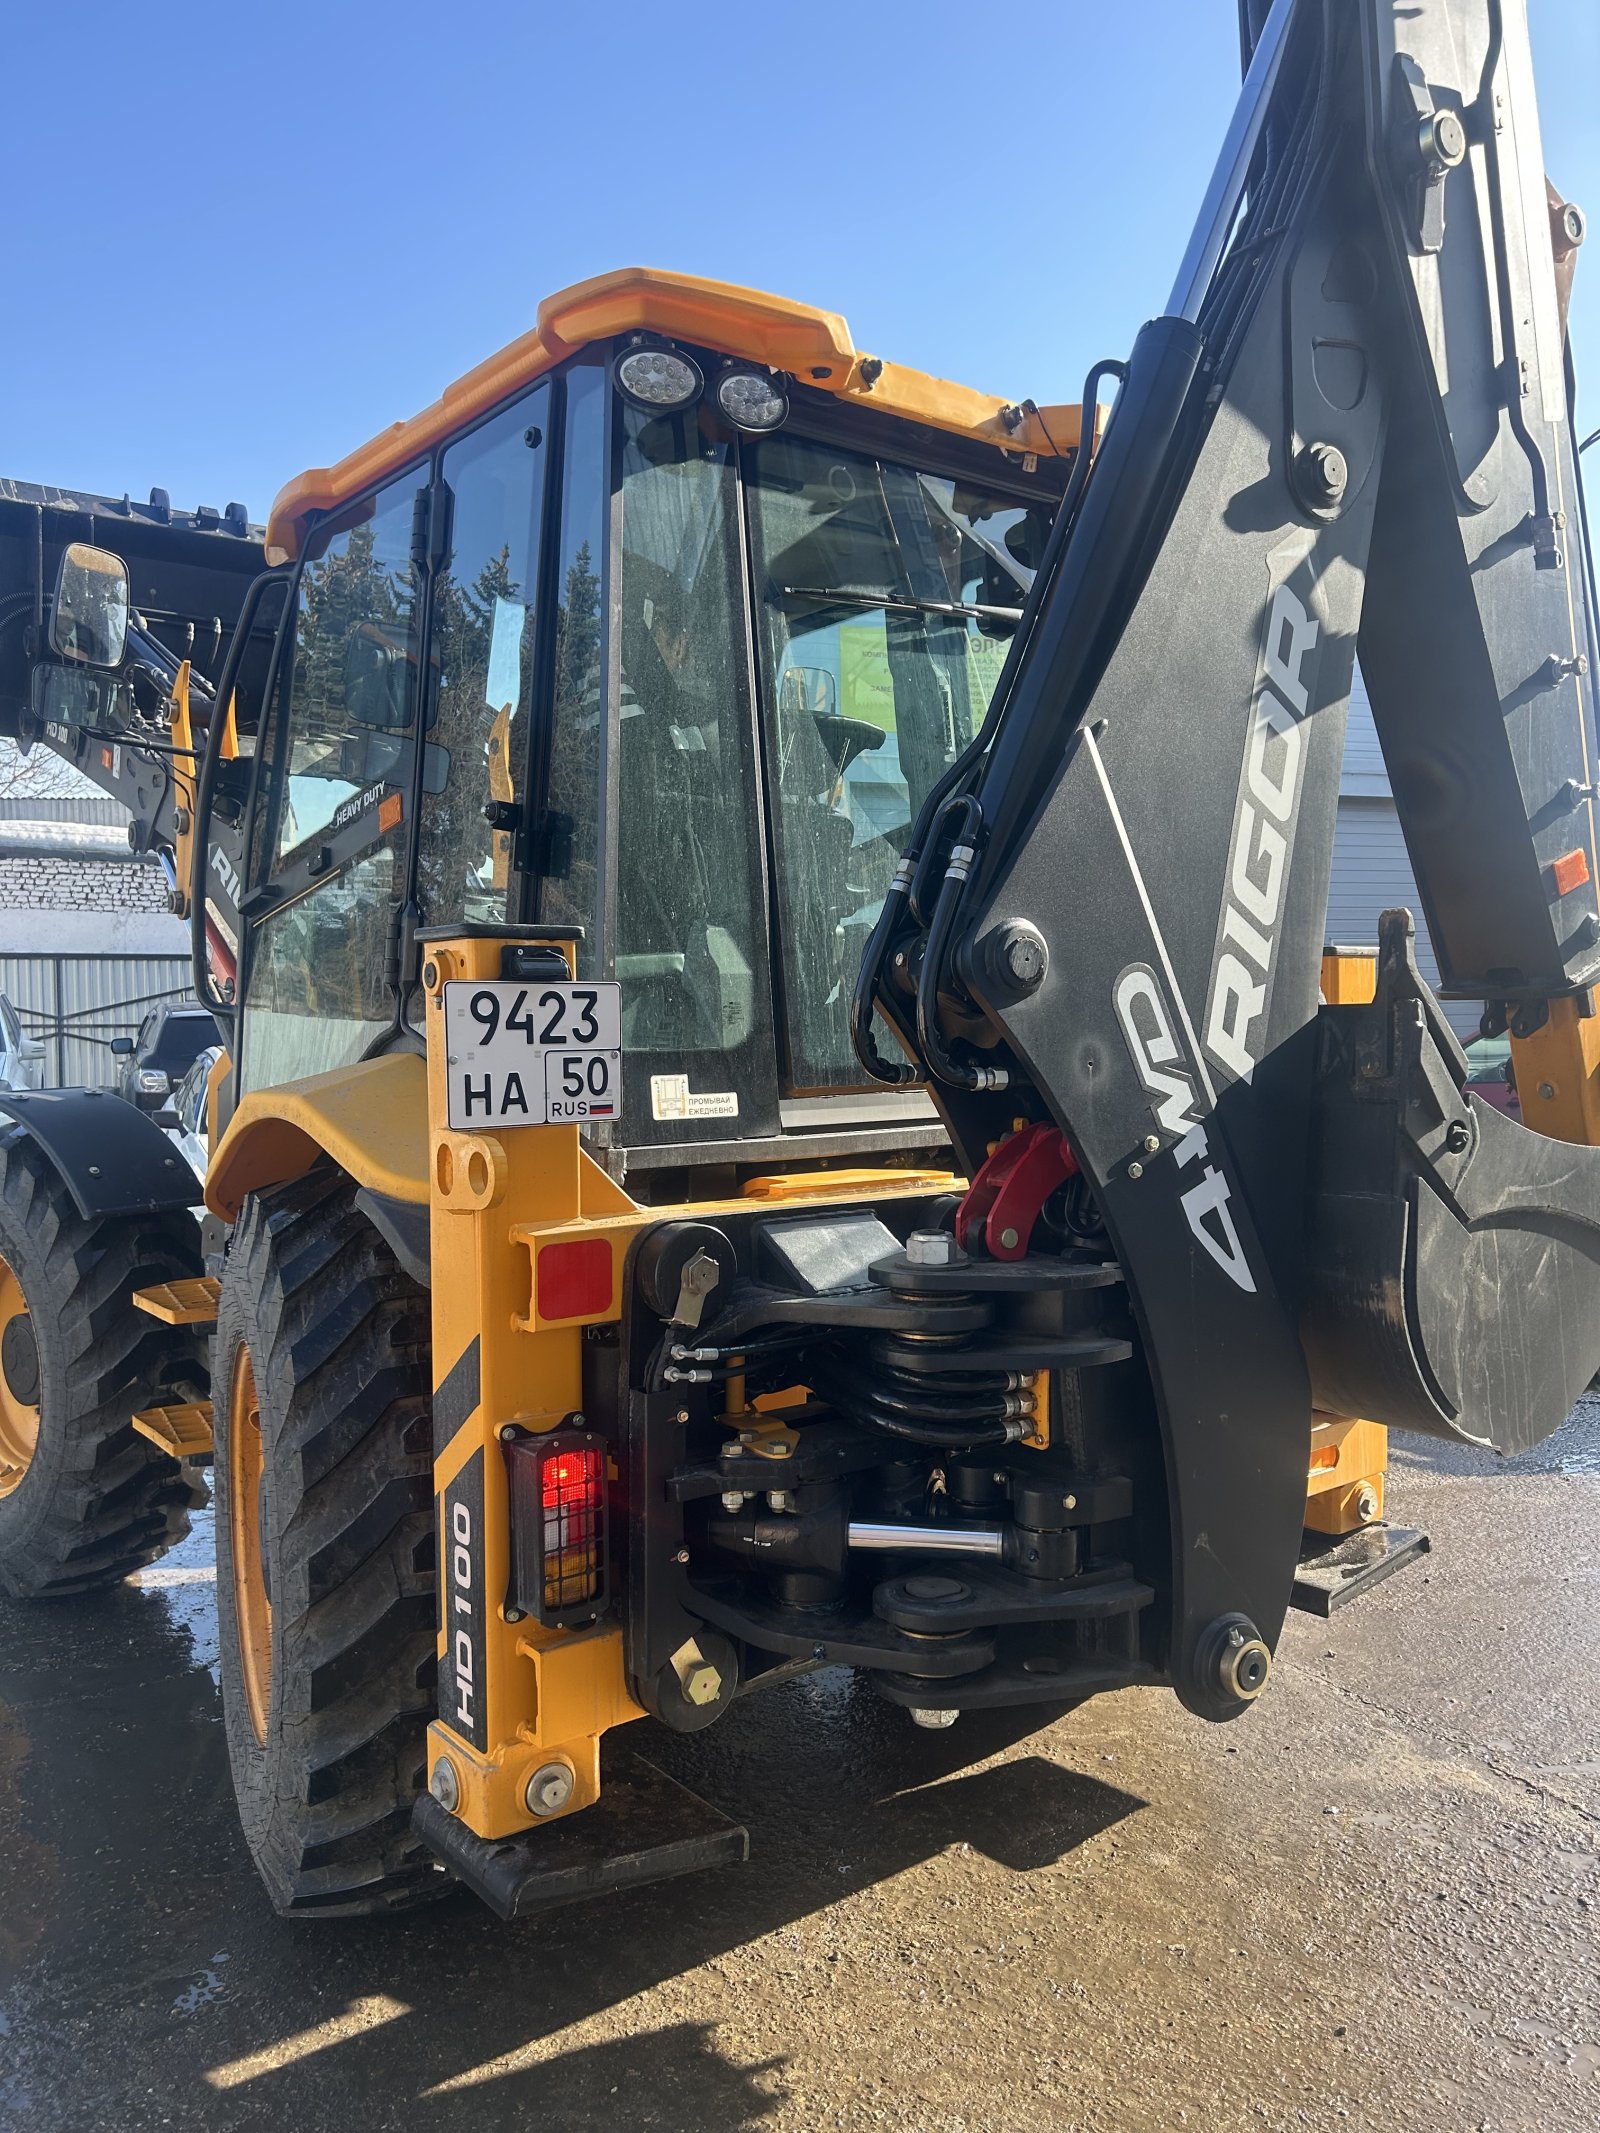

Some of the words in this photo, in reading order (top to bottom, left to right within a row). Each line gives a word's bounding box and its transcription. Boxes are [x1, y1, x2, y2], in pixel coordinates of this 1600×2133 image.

[58, 725, 69, 744] 100
[336, 797, 362, 827] HEAVY
[363, 780, 385, 807] DUTY
[1206, 584, 1319, 1086] RIGOR
[470, 990, 599, 1046] 9423
[562, 1056, 609, 1098] 50
[552, 1101, 588, 1117] RUS
[688, 1096, 731, 1106] ПРОМЫВАЙ
[688, 1106, 734, 1116] ЕЖЕДНЕВНО
[1117, 971, 1258, 1293] 4WD
[453, 1502, 472, 1615] 100
[455, 1629, 474, 1729] HD
